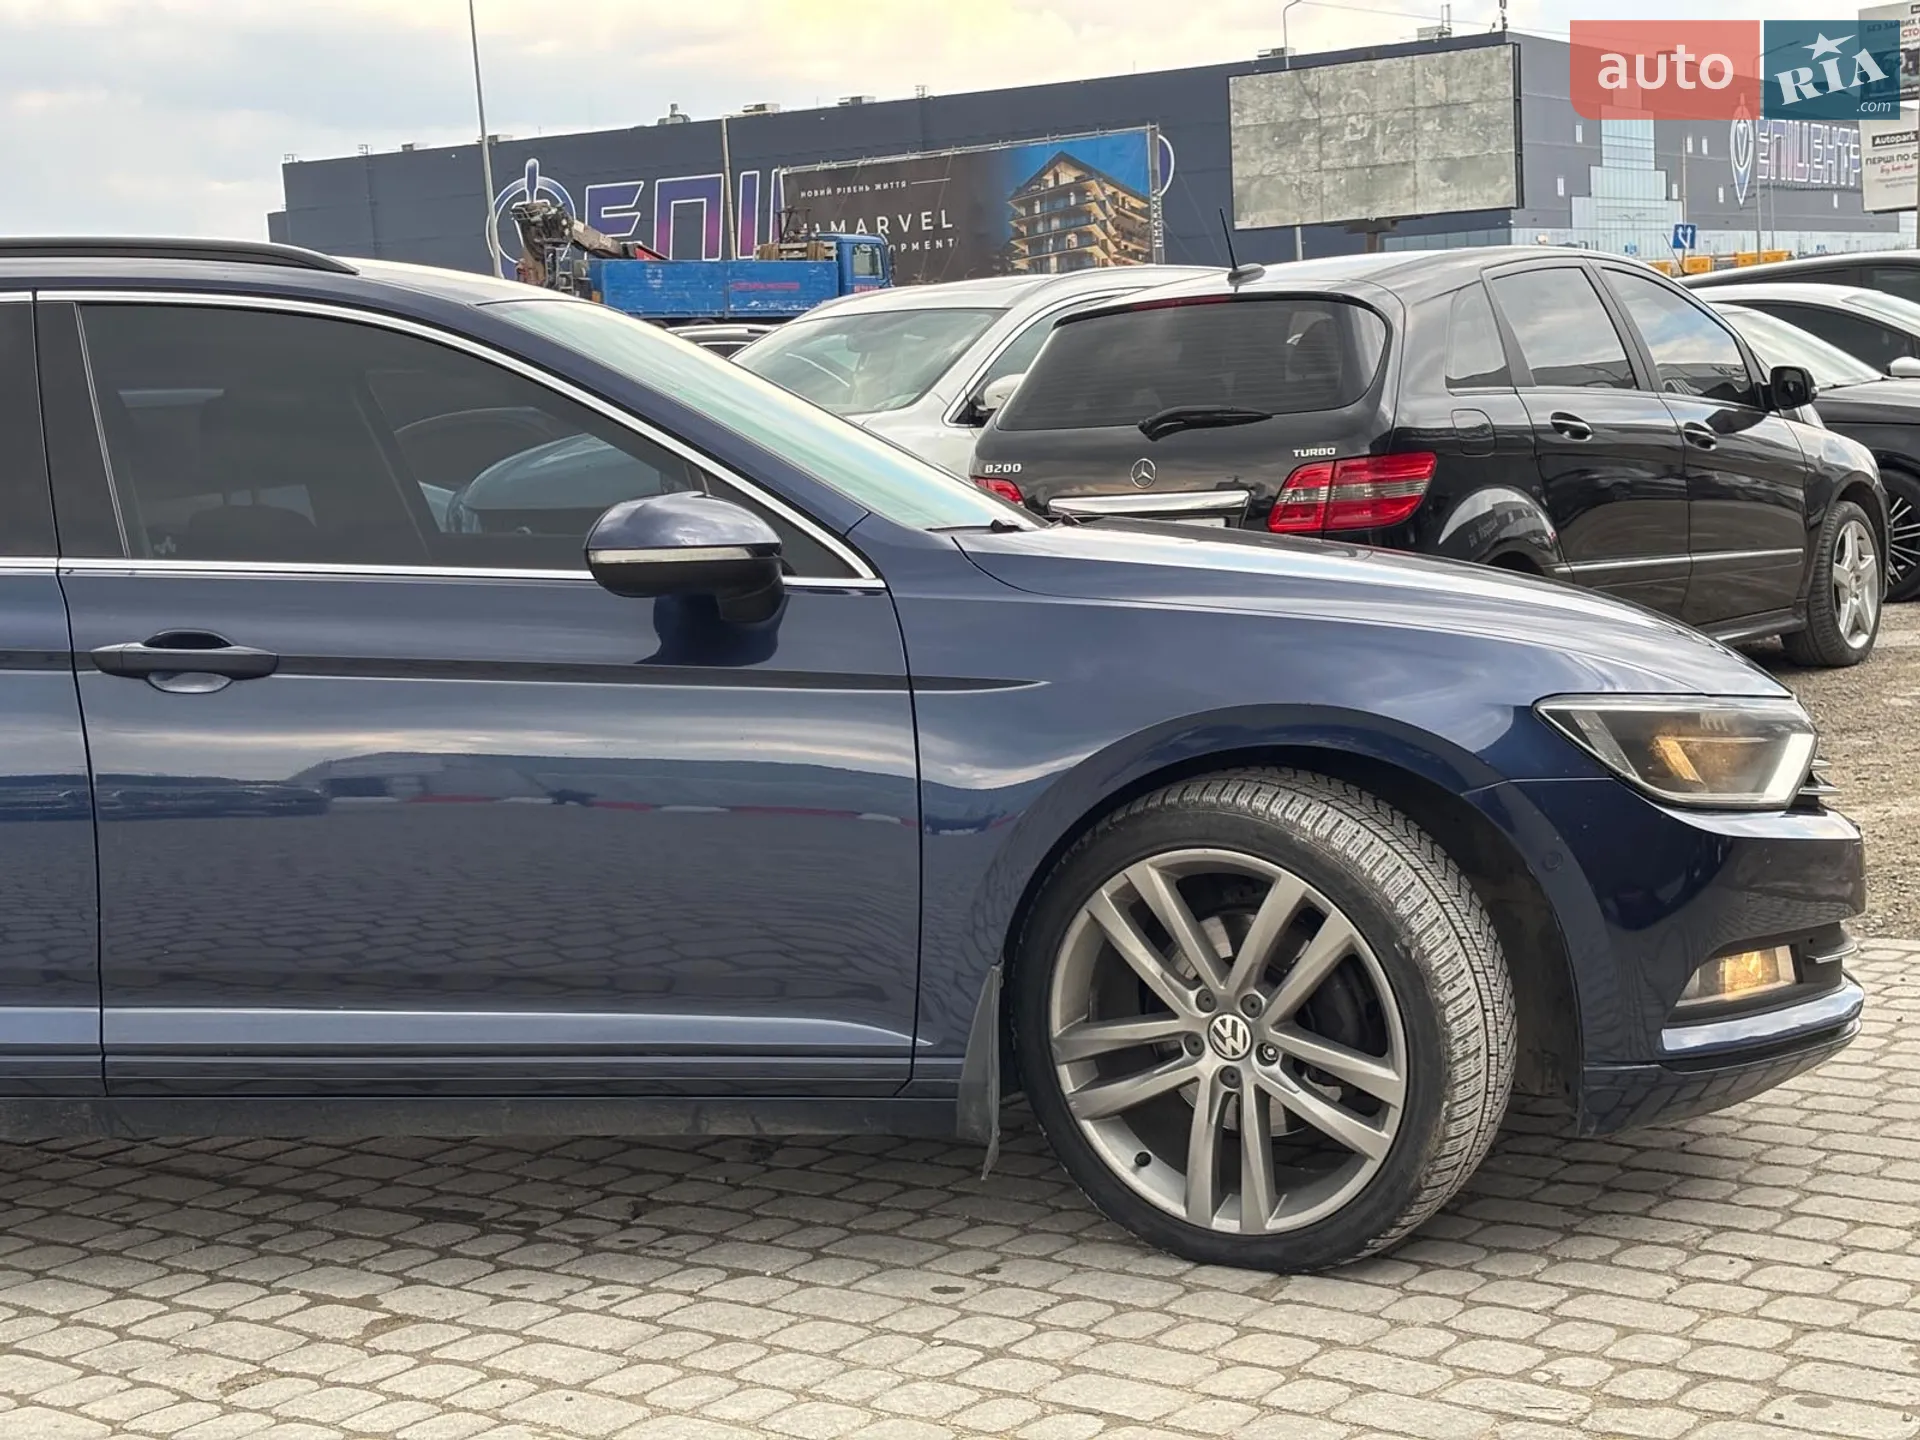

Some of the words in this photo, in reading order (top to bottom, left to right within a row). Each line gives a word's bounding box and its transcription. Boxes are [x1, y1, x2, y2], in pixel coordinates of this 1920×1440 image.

[1875, 132, 1916, 145] Autopark
[800, 187, 833, 198] НОВИЙ
[836, 184, 870, 194] РІВЕНЬ
[874, 180, 907, 190] ЖИТТЯ
[1293, 447, 1336, 458] TURBO
